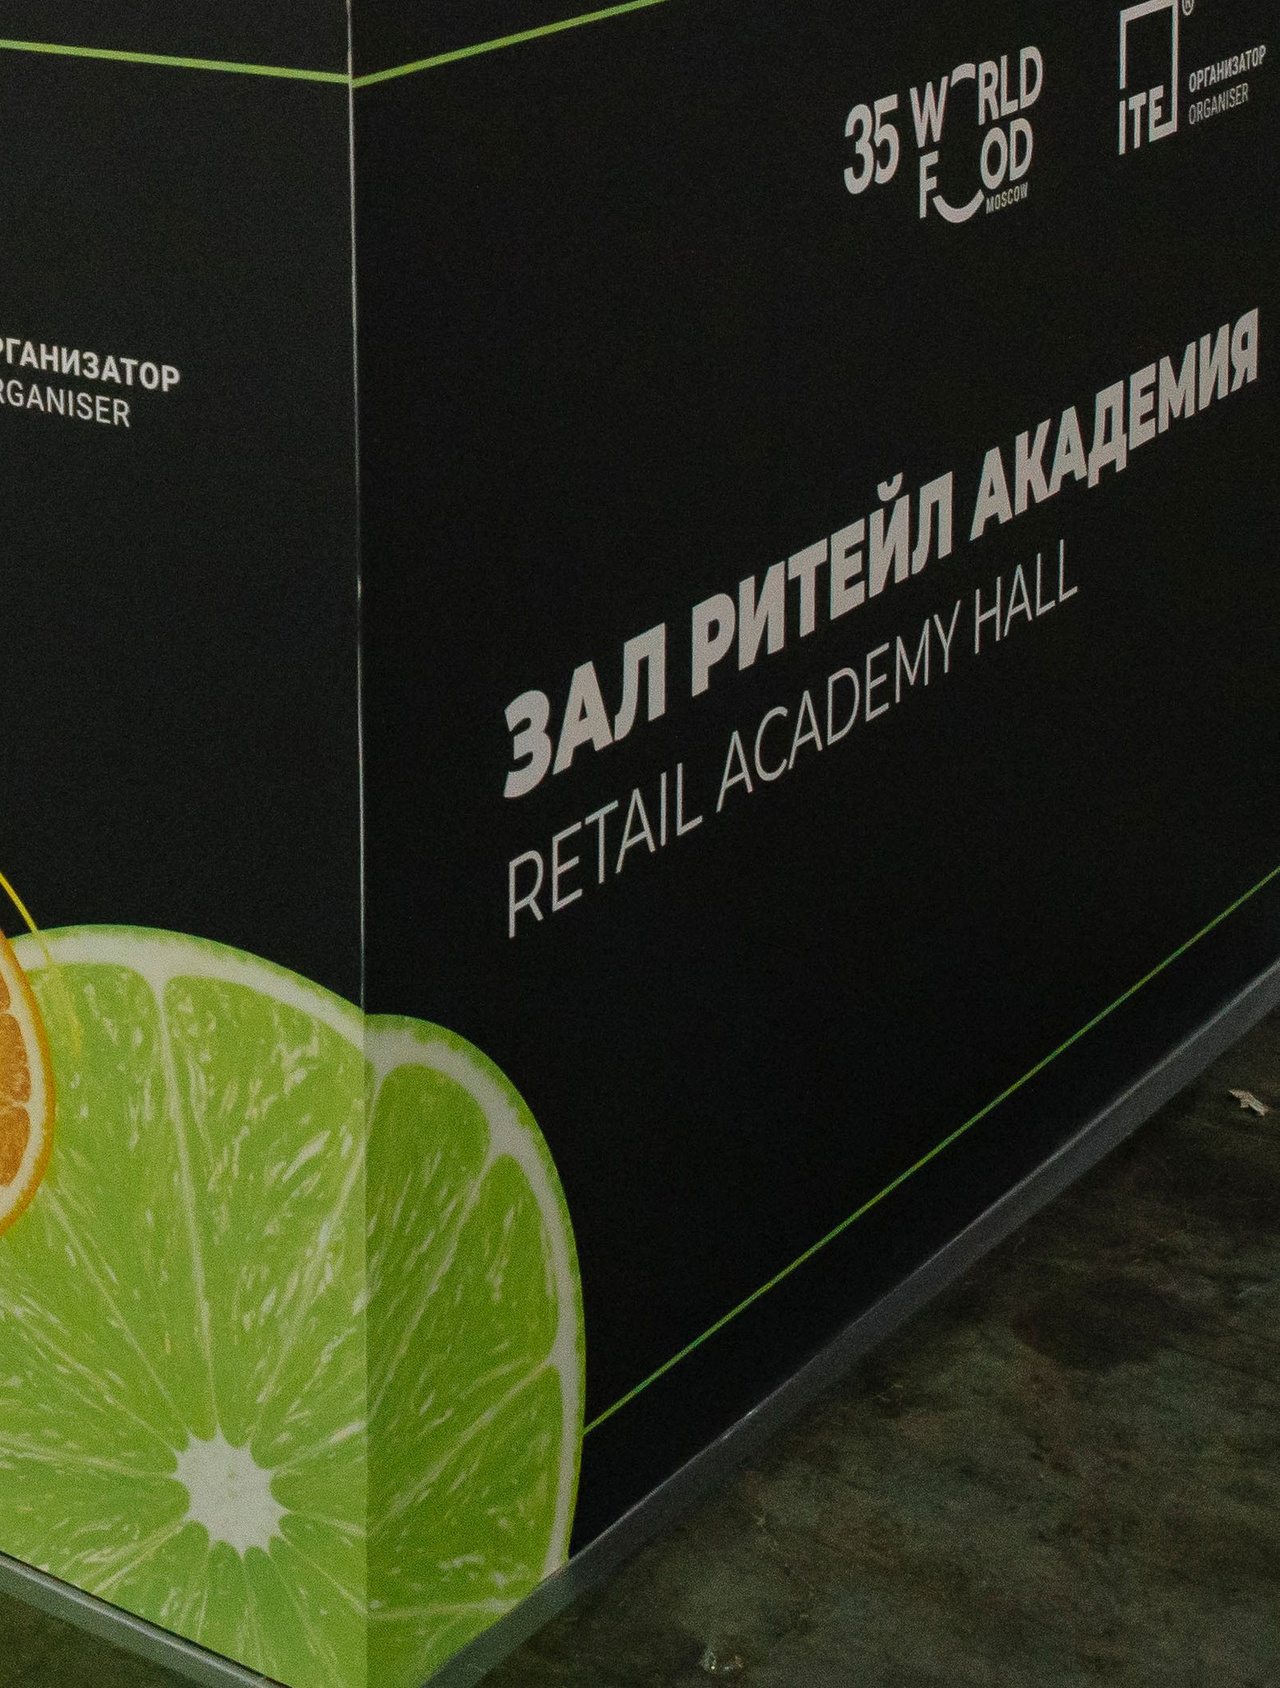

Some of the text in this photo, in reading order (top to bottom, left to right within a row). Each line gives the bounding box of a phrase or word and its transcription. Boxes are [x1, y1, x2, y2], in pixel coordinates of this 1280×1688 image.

[1188, 44, 1267, 94] ОРГАНИЗАТОР
[1188, 82, 1250, 126] ORGANISER
[843, 93, 900, 195] 35
[986, 181, 1029, 215] MOSCOW
[502, 307, 1260, 799] ЗАЛ РИТЕЙЛ АКАДЕМИЯ
[508, 538, 1079, 940] RETAIL ACADEMY HALL
